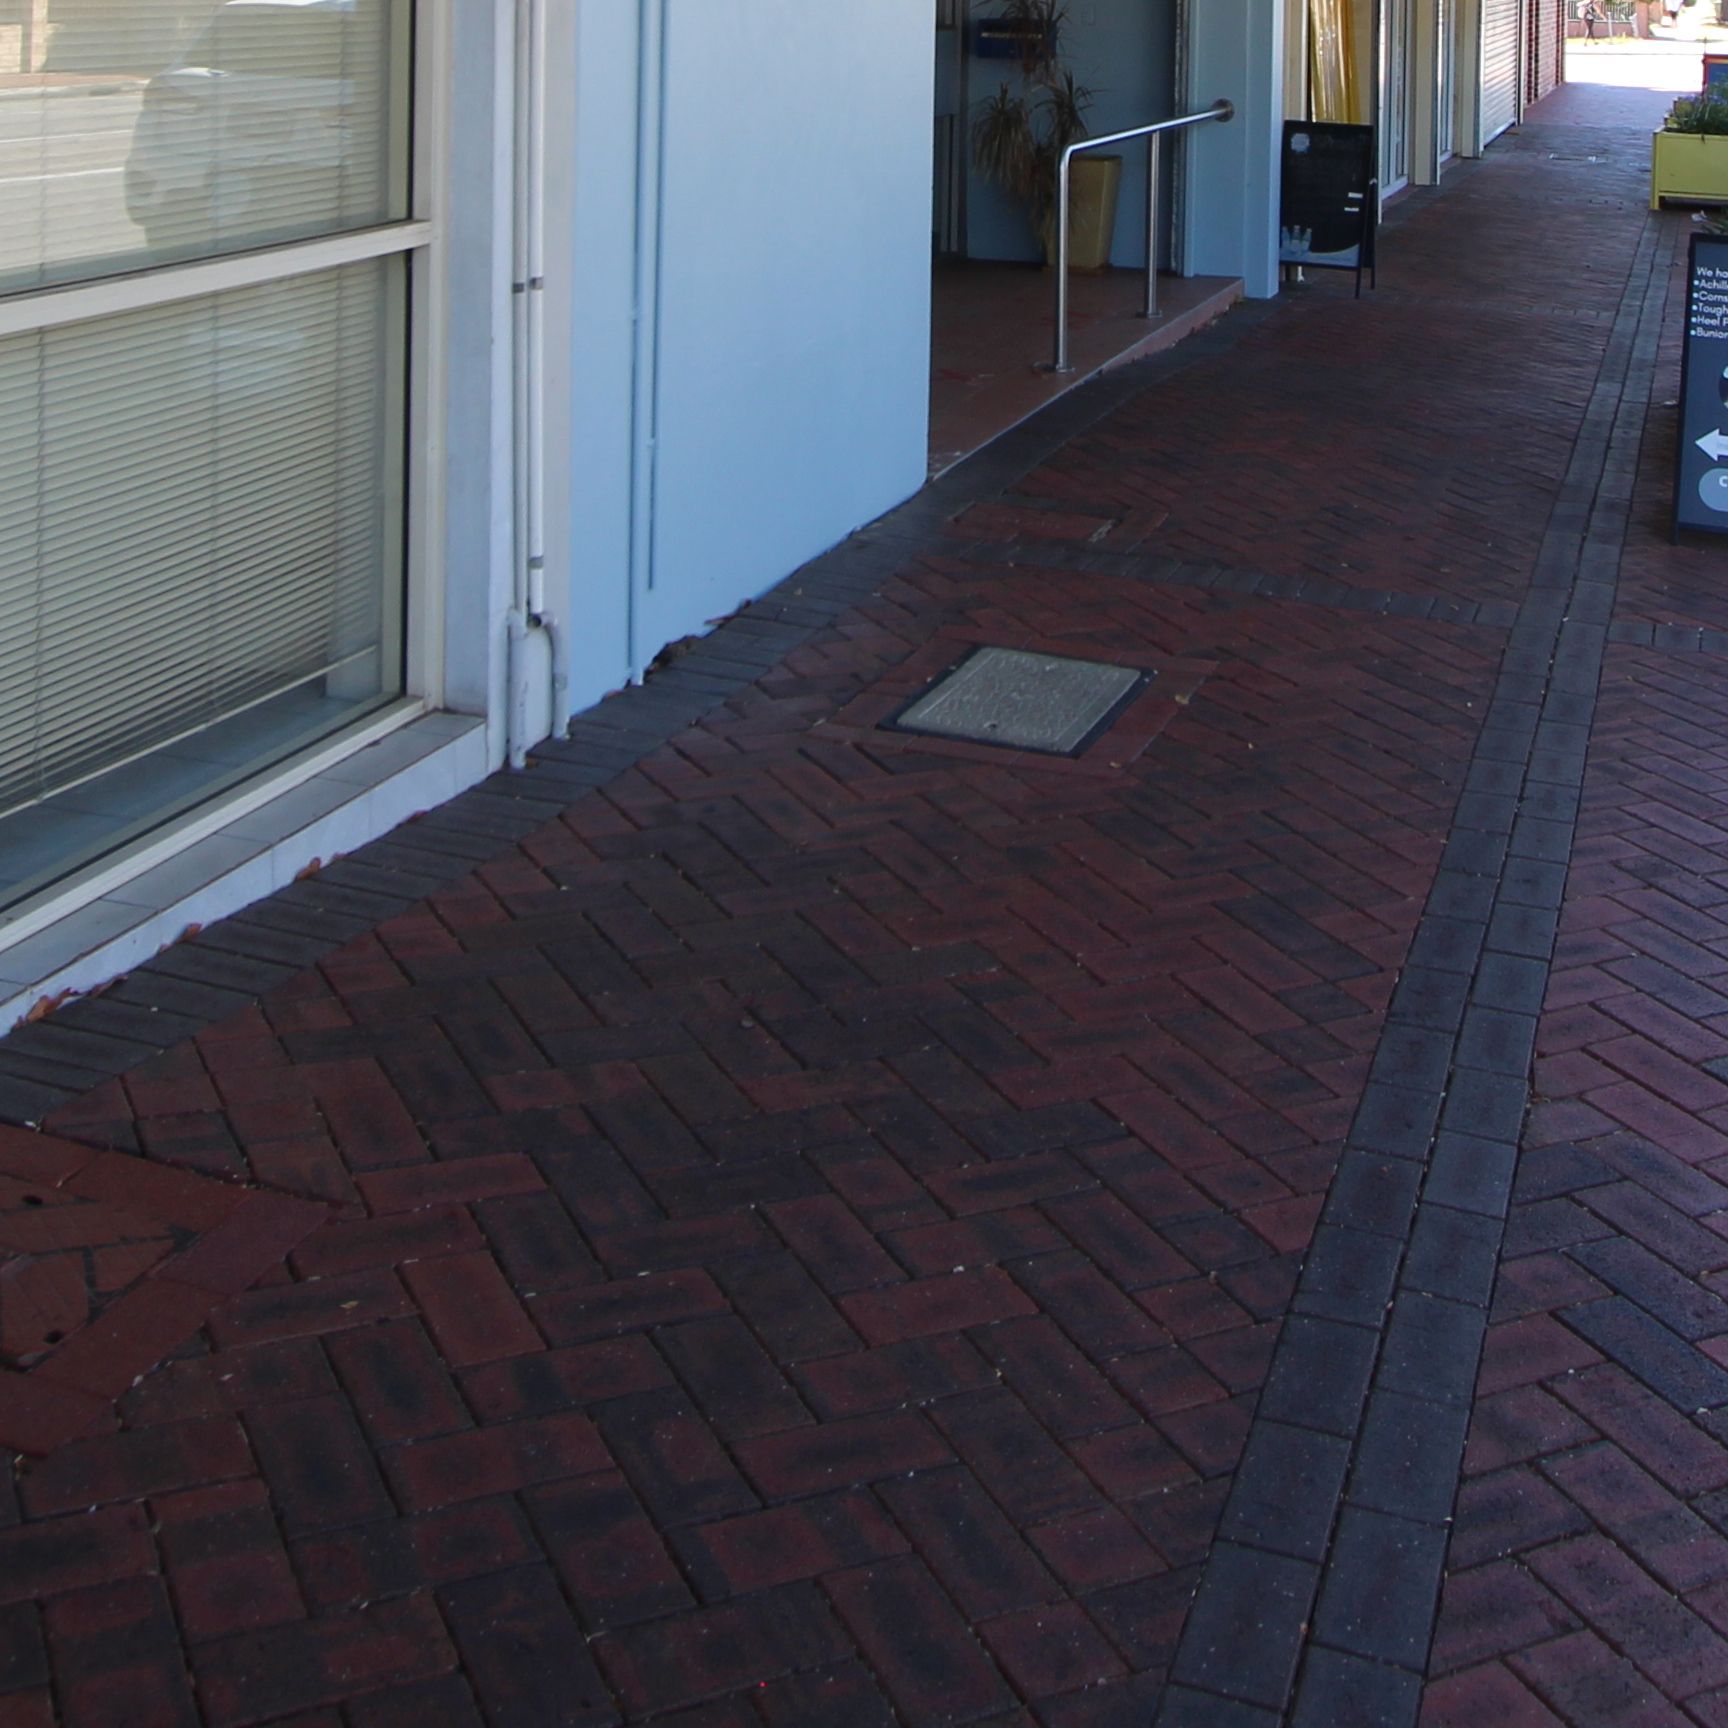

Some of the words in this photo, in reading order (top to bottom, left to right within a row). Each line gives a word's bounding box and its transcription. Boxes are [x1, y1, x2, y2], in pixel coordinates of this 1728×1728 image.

[1697, 267, 1713, 277] We
[1699, 291, 1728, 303] Corns
[1698, 303, 1728, 316] Tough
[1697, 315, 1720, 326] Heel
